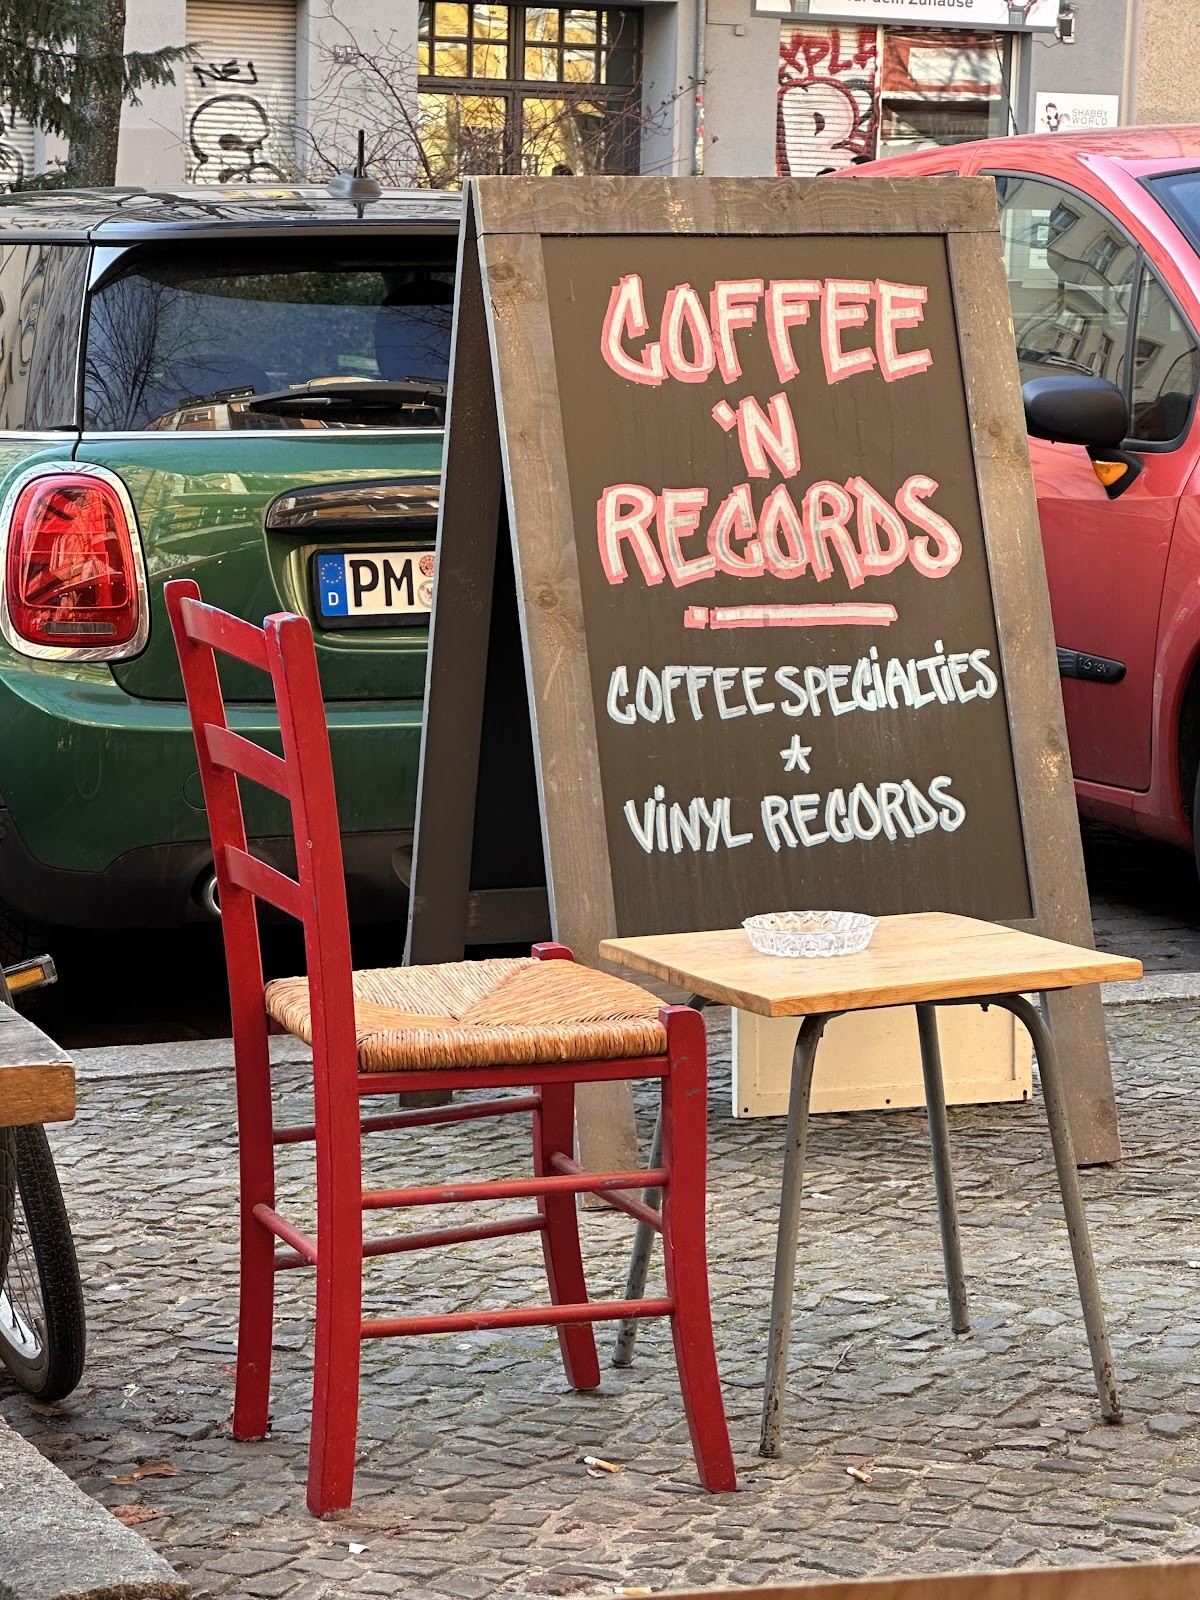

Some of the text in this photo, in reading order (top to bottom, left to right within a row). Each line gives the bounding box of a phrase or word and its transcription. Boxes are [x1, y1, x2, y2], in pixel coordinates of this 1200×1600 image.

[1072, 108, 1109, 118] SHABBY
[1072, 116, 1108, 126] WORLD
[601, 274, 933, 385] COFFEE
[712, 392, 801, 478] 'N
[597, 475, 962, 589] RECORDS
[328, 592, 339, 606] D
[349, 559, 415, 607] PM
[607, 665, 775, 724] COFFEE
[761, 775, 967, 852] RECORDS
